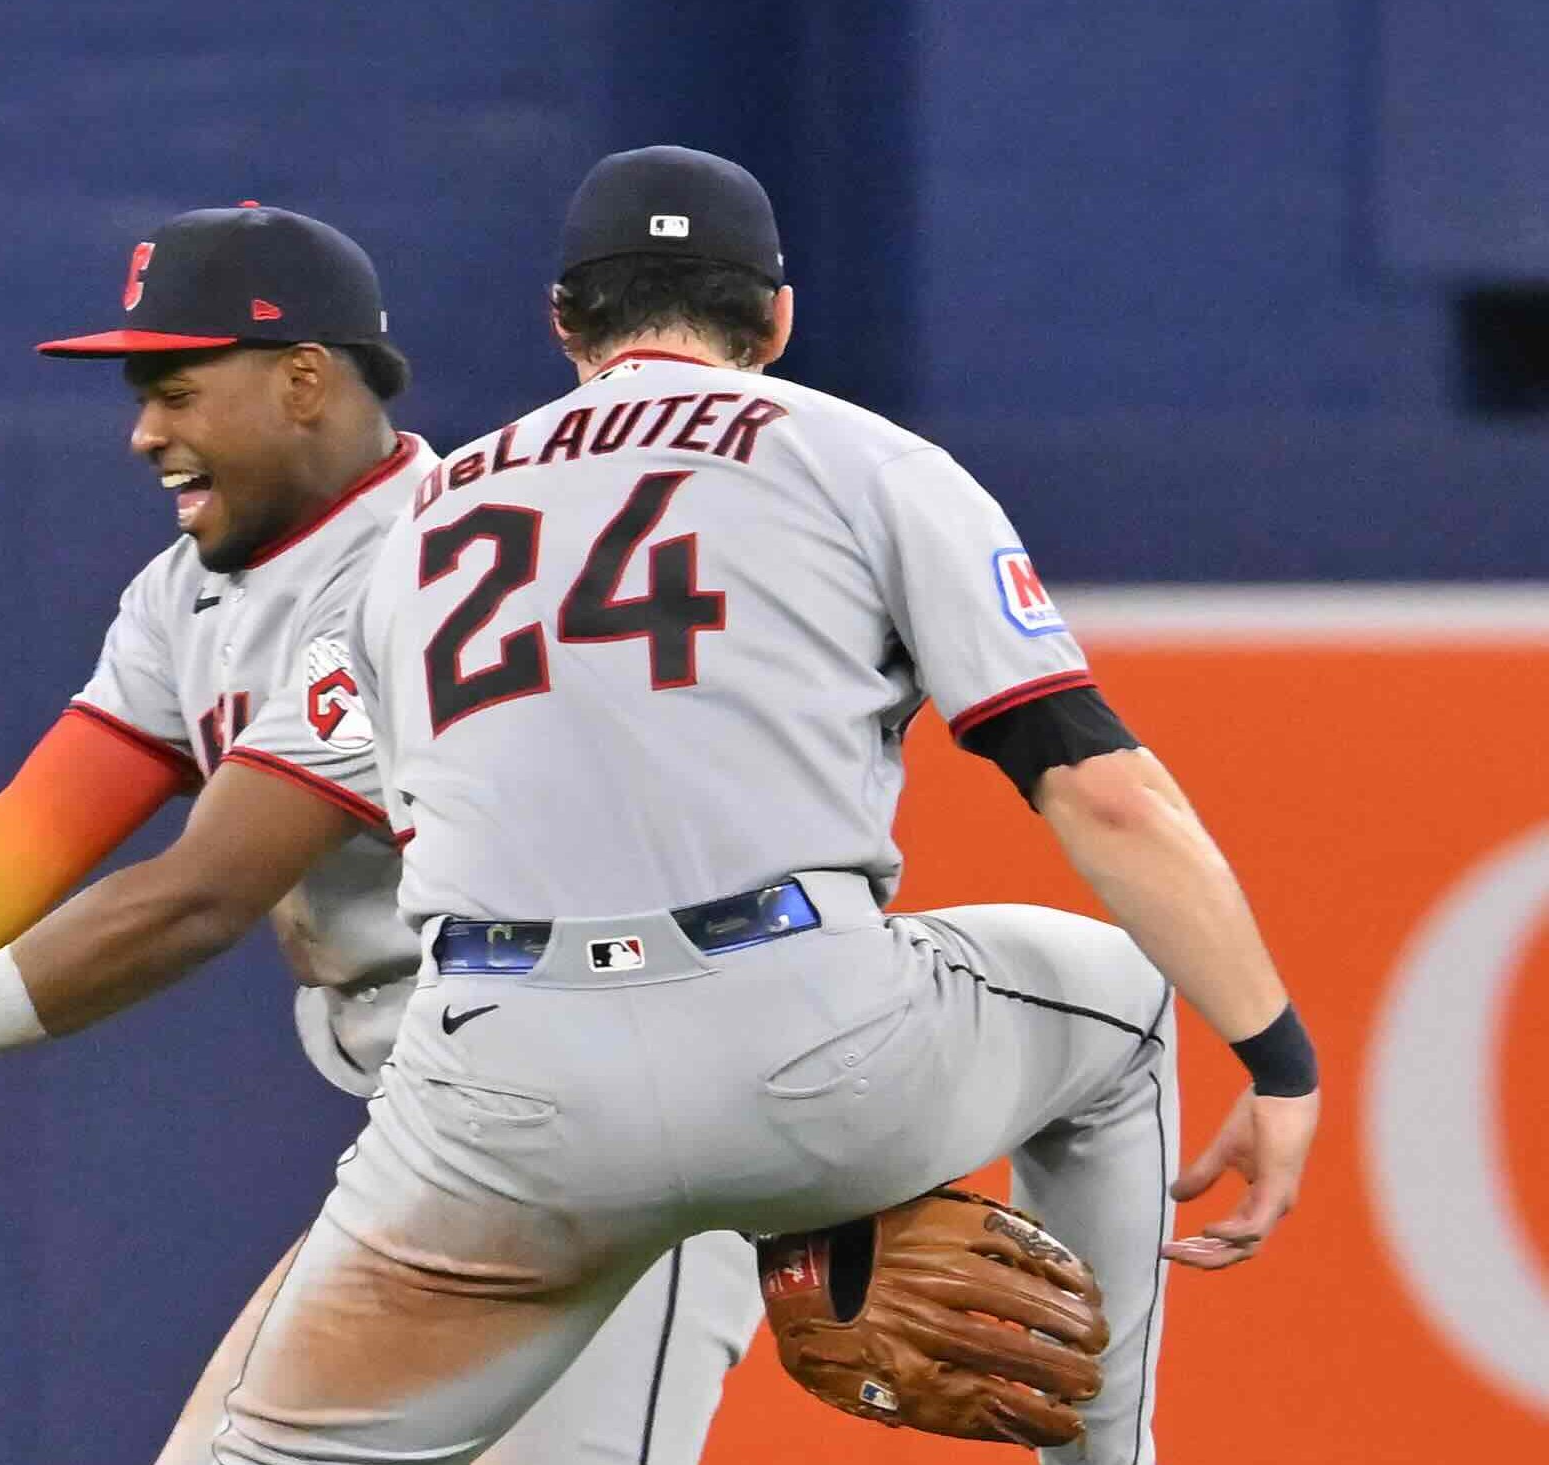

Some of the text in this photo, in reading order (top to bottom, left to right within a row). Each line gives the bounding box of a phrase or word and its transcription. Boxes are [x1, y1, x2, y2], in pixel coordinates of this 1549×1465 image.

[413, 392, 790, 521] DeLAUTER
[417, 469, 727, 741] 24
[1007, 559, 1046, 608] M
